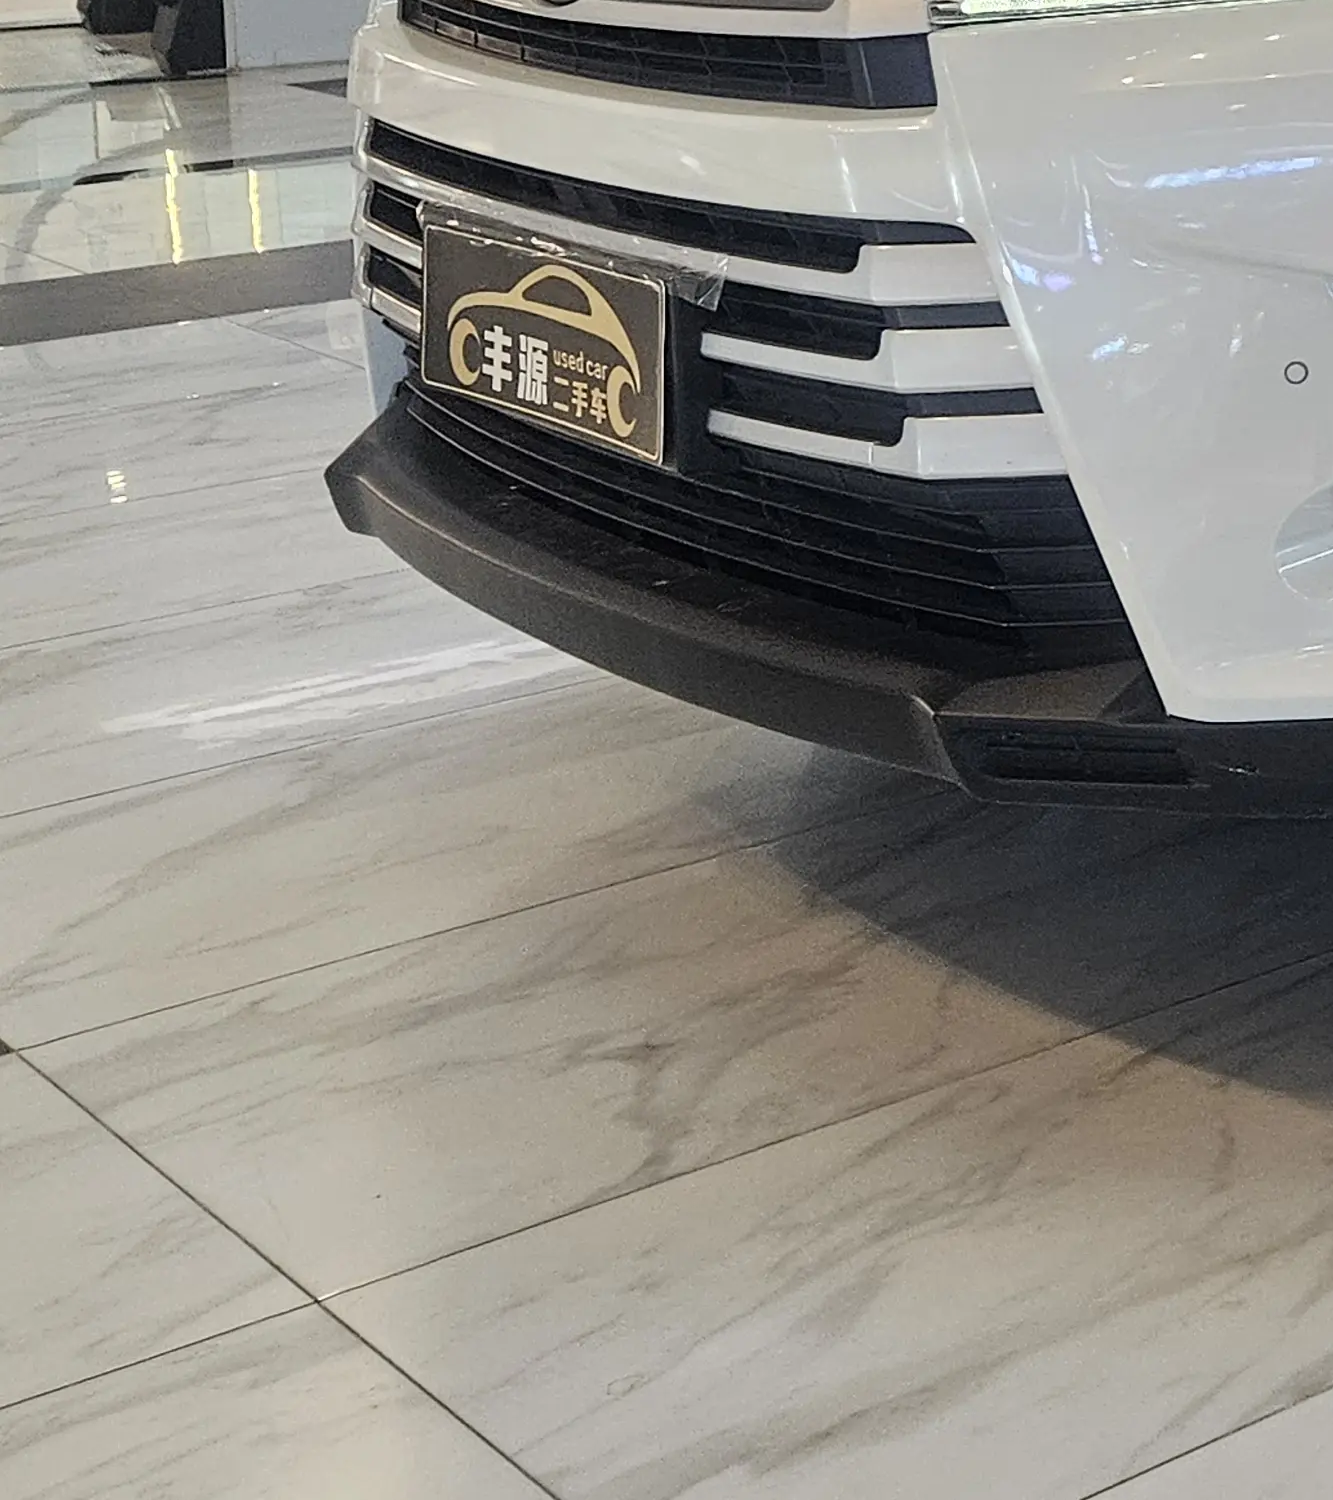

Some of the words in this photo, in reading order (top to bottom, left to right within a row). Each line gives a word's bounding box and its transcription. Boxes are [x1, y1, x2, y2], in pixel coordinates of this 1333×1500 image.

[481, 325, 549, 406] 丰源
[553, 349, 584, 374] used
[586, 360, 608, 381] car
[553, 376, 608, 424] 二手车
